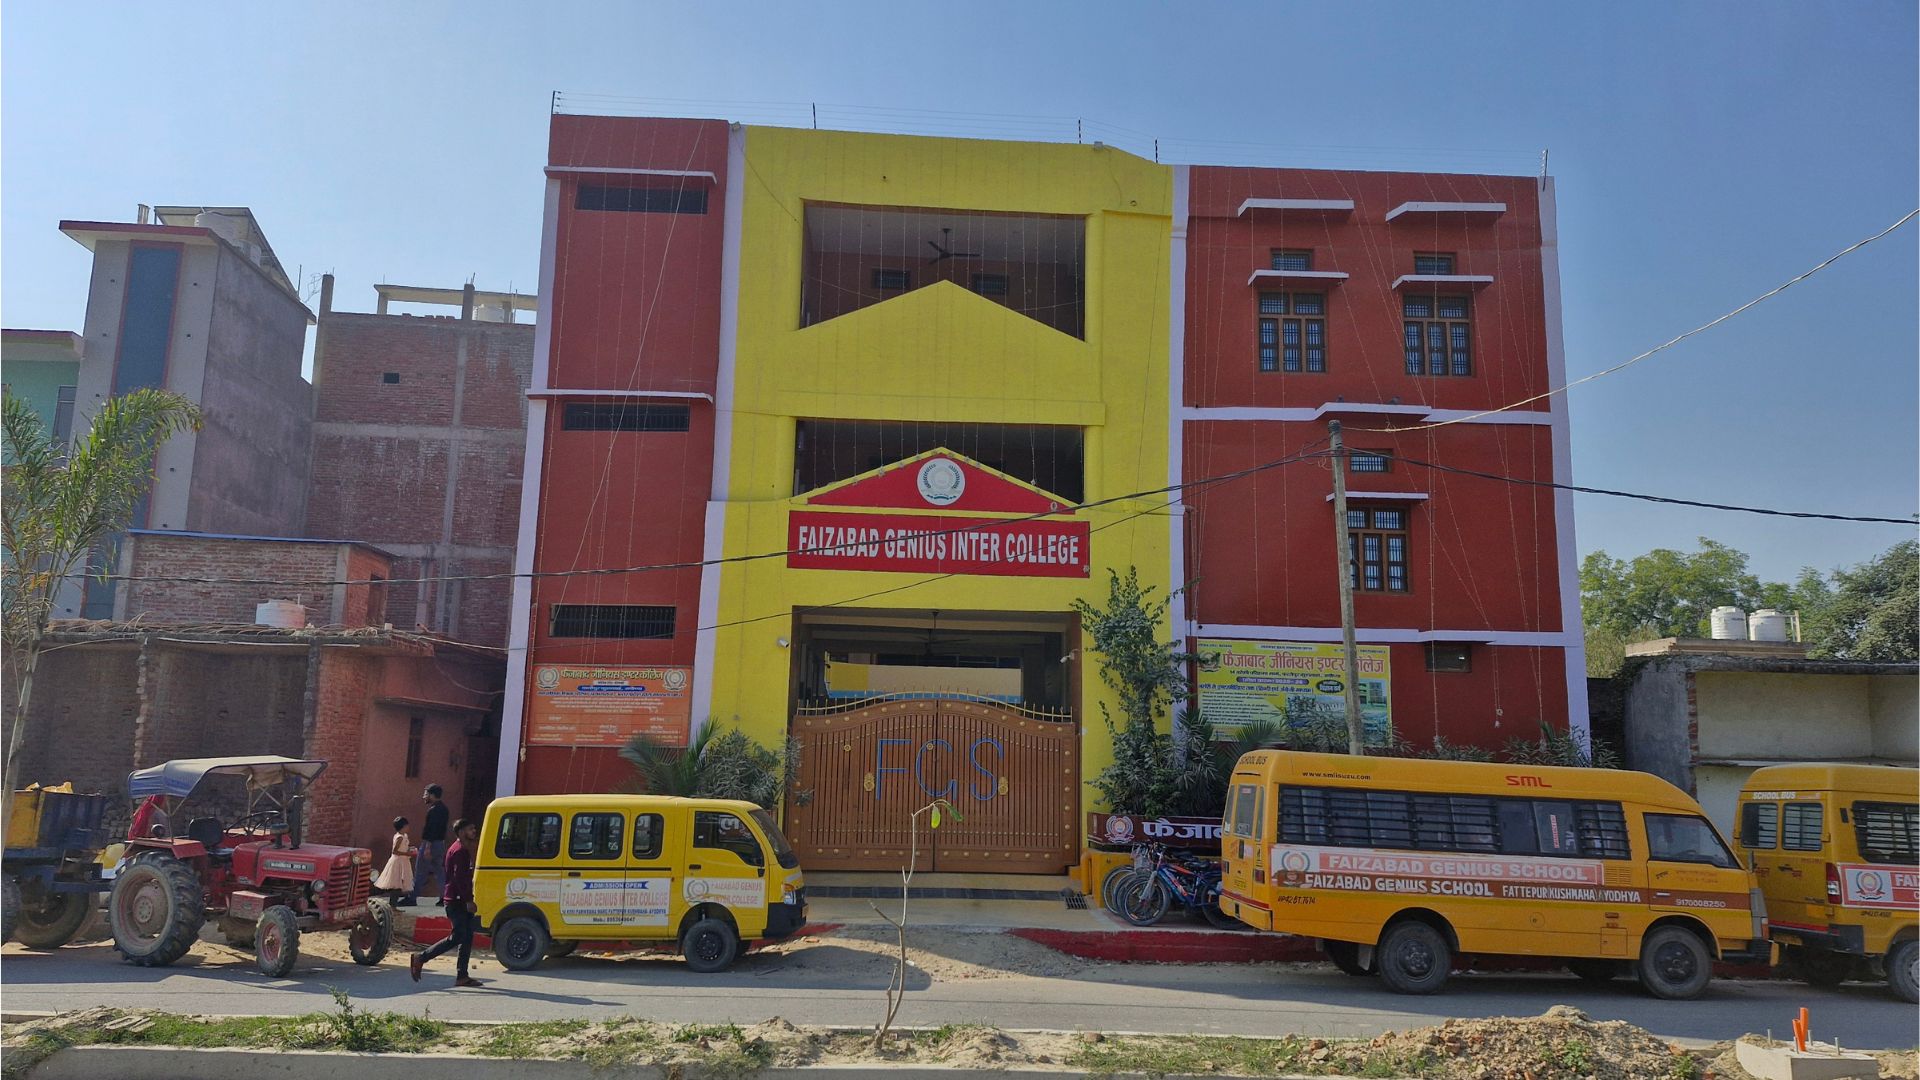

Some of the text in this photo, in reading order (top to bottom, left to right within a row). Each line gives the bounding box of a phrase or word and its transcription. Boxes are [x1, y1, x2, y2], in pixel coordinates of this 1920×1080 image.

[799, 526, 1079, 565] FAIZABAD GENIUS INTER COLLEGE
[1356, 655, 1384, 672] ॉलेज
[1506, 775, 1552, 788] SML
[1328, 855, 1588, 880] FAIZABAD GENIUS SCHOOL
[1304, 874, 1372, 890] FAIZABAD
[1431, 880, 1494, 897] SCHOOL
[1895, 874, 1919, 887] FAI
